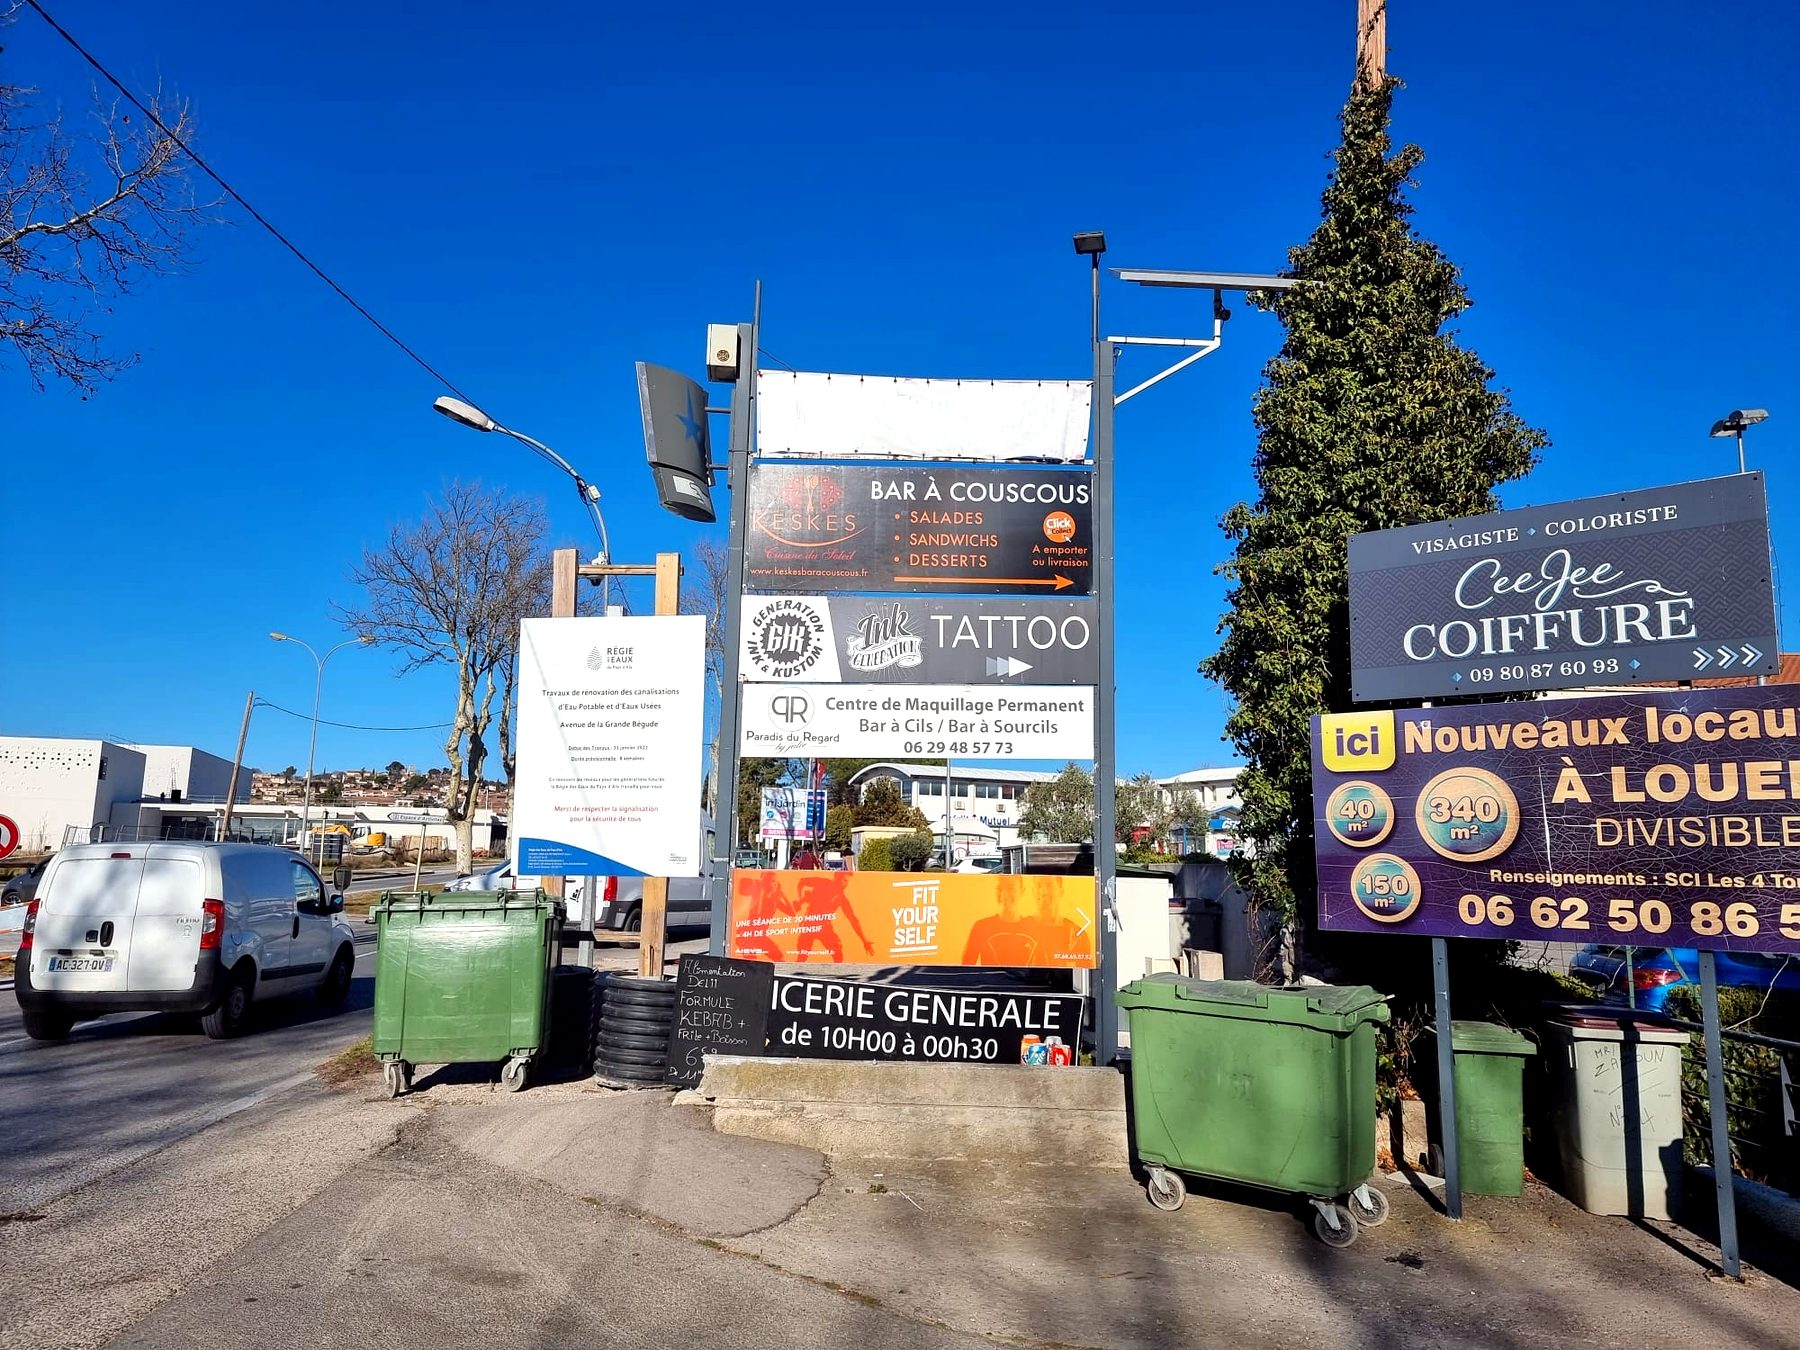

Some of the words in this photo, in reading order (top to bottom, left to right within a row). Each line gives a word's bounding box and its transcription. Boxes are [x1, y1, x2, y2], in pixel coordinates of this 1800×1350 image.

[871, 481, 916, 500] BAR
[924, 476, 942, 500] À
[950, 482, 1089, 504] COUSCOUS
[752, 513, 856, 531] KESKES
[910, 511, 983, 525] SALADES
[1046, 517, 1071, 528] Click
[1412, 527, 1519, 554] VISAGISTE
[1545, 505, 1678, 536] COLORISTE
[909, 533, 998, 547] SANDWICHS
[909, 553, 988, 567] DESSERTS
[1032, 545, 1041, 553] A
[1043, 546, 1088, 556] emporter
[1047, 556, 1088, 566] livraison
[750, 567, 869, 577] www.keskesbaracouscous.fr
[753, 600, 824, 632] GENERATION
[857, 603, 912, 650] Ink
[931, 613, 1091, 650] TATTOO
[1403, 598, 1696, 661] COIFFURE
[607, 645, 633, 655] RÉGIE
[747, 641, 764, 665] INK
[772, 646, 823, 677] KUSTOM
[853, 640, 919, 667] GENERATION
[1470, 668, 1494, 682] 09
[1500, 665, 1524, 681] 80
[1531, 663, 1553, 679] 87
[1560, 660, 1586, 676] 60
[1593, 658, 1619, 674] 93
[542, 689, 570, 697] Travaux
[558, 703, 577, 711] d'Eau
[825, 697, 877, 711] Centre
[882, 697, 901, 711] de
[905, 698, 994, 715] Maquillage
[998, 699, 1085, 713] Permanent
[605, 720, 631, 728] Grande
[632, 720, 659, 730] Bégude
[859, 719, 886, 732] Bar
[891, 719, 899, 732] à
[905, 719, 933, 733] Cils
[938, 719, 944, 733] /
[949, 720, 975, 733] Bar
[980, 720, 989, 733] à
[994, 720, 1058, 734] Sourcils
[1404, 716, 1631, 753] Nouveaux
[1645, 707, 1800, 743] locau
[746, 730, 783, 741] Paradis
[786, 733, 799, 742] du
[803, 731, 840, 744] Regard
[1336, 726, 1379, 756] ici
[904, 742, 922, 753] 06
[927, 742, 945, 754] 29
[949, 742, 968, 754] 48
[973, 742, 990, 754] 57
[995, 742, 1013, 754] 73
[1551, 756, 1592, 804] À
[581, 805, 610, 814] respecter
[619, 805, 659, 814] signalisation
[592, 814, 617, 822] sécurité
[1340, 799, 1374, 819] 40
[1430, 796, 1499, 824] 340
[980, 815, 1010, 826] Mutuel
[1361, 874, 1410, 895] 150
[1490, 869, 1646, 887] Renseignements
[1664, 872, 1701, 887] SCI
[1707, 873, 1746, 888] Les
[1752, 874, 1765, 888] 4
[1770, 874, 1800, 889] To
[913, 886, 940, 905] FIT
[736, 918, 750, 928] UNE
[752, 916, 781, 927] SÉANCE
[783, 915, 793, 923] DE
[805, 912, 837, 921] MINUTES
[892, 905, 939, 926] YOUR
[1458, 894, 1515, 927] 06
[1530, 896, 1590, 930] 62
[1607, 899, 1671, 934] 50
[1690, 901, 1760, 937] 86
[742, 930, 753, 938] 4H
[754, 929, 764, 937] DE
[766, 928, 788, 936] SPORT
[791, 925, 823, 934] INTENSIF
[894, 925, 937, 946] SELF
[683, 960, 747, 978] Alimentation
[680, 990, 736, 1010] FORMULE
[771, 980, 875, 1019] ICERIE
[884, 991, 1061, 1030] GENERALE
[680, 1009, 733, 1030] KEBAB
[781, 1022, 812, 1046] de
[821, 1026, 897, 1054] 10H00
[902, 1033, 915, 1056] à
[922, 1035, 998, 1060] 00h30
